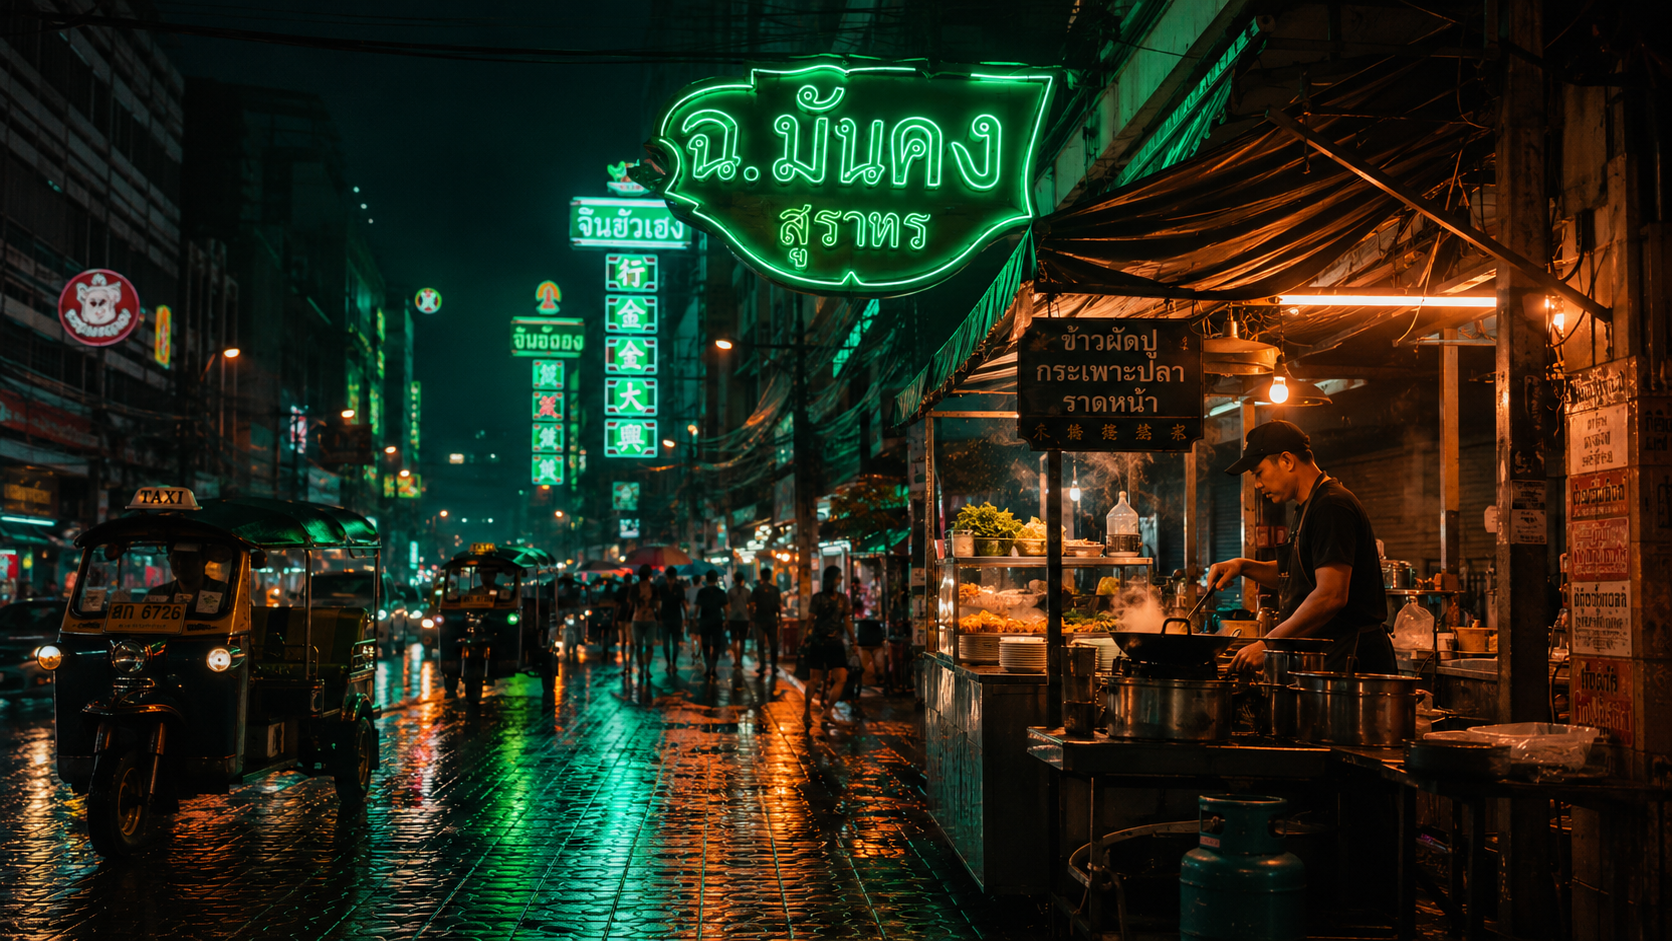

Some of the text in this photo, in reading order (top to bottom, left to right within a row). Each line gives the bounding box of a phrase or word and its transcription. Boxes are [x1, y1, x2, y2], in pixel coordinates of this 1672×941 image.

[1061, 325, 1158, 359] ข้าวผัดปู
[1036, 360, 1185, 383] กระเพาะปลา
[1062, 387, 1158, 413] ราดหน้า
[140, 490, 184, 504] TAXI
[141, 605, 181, 620] 6726
